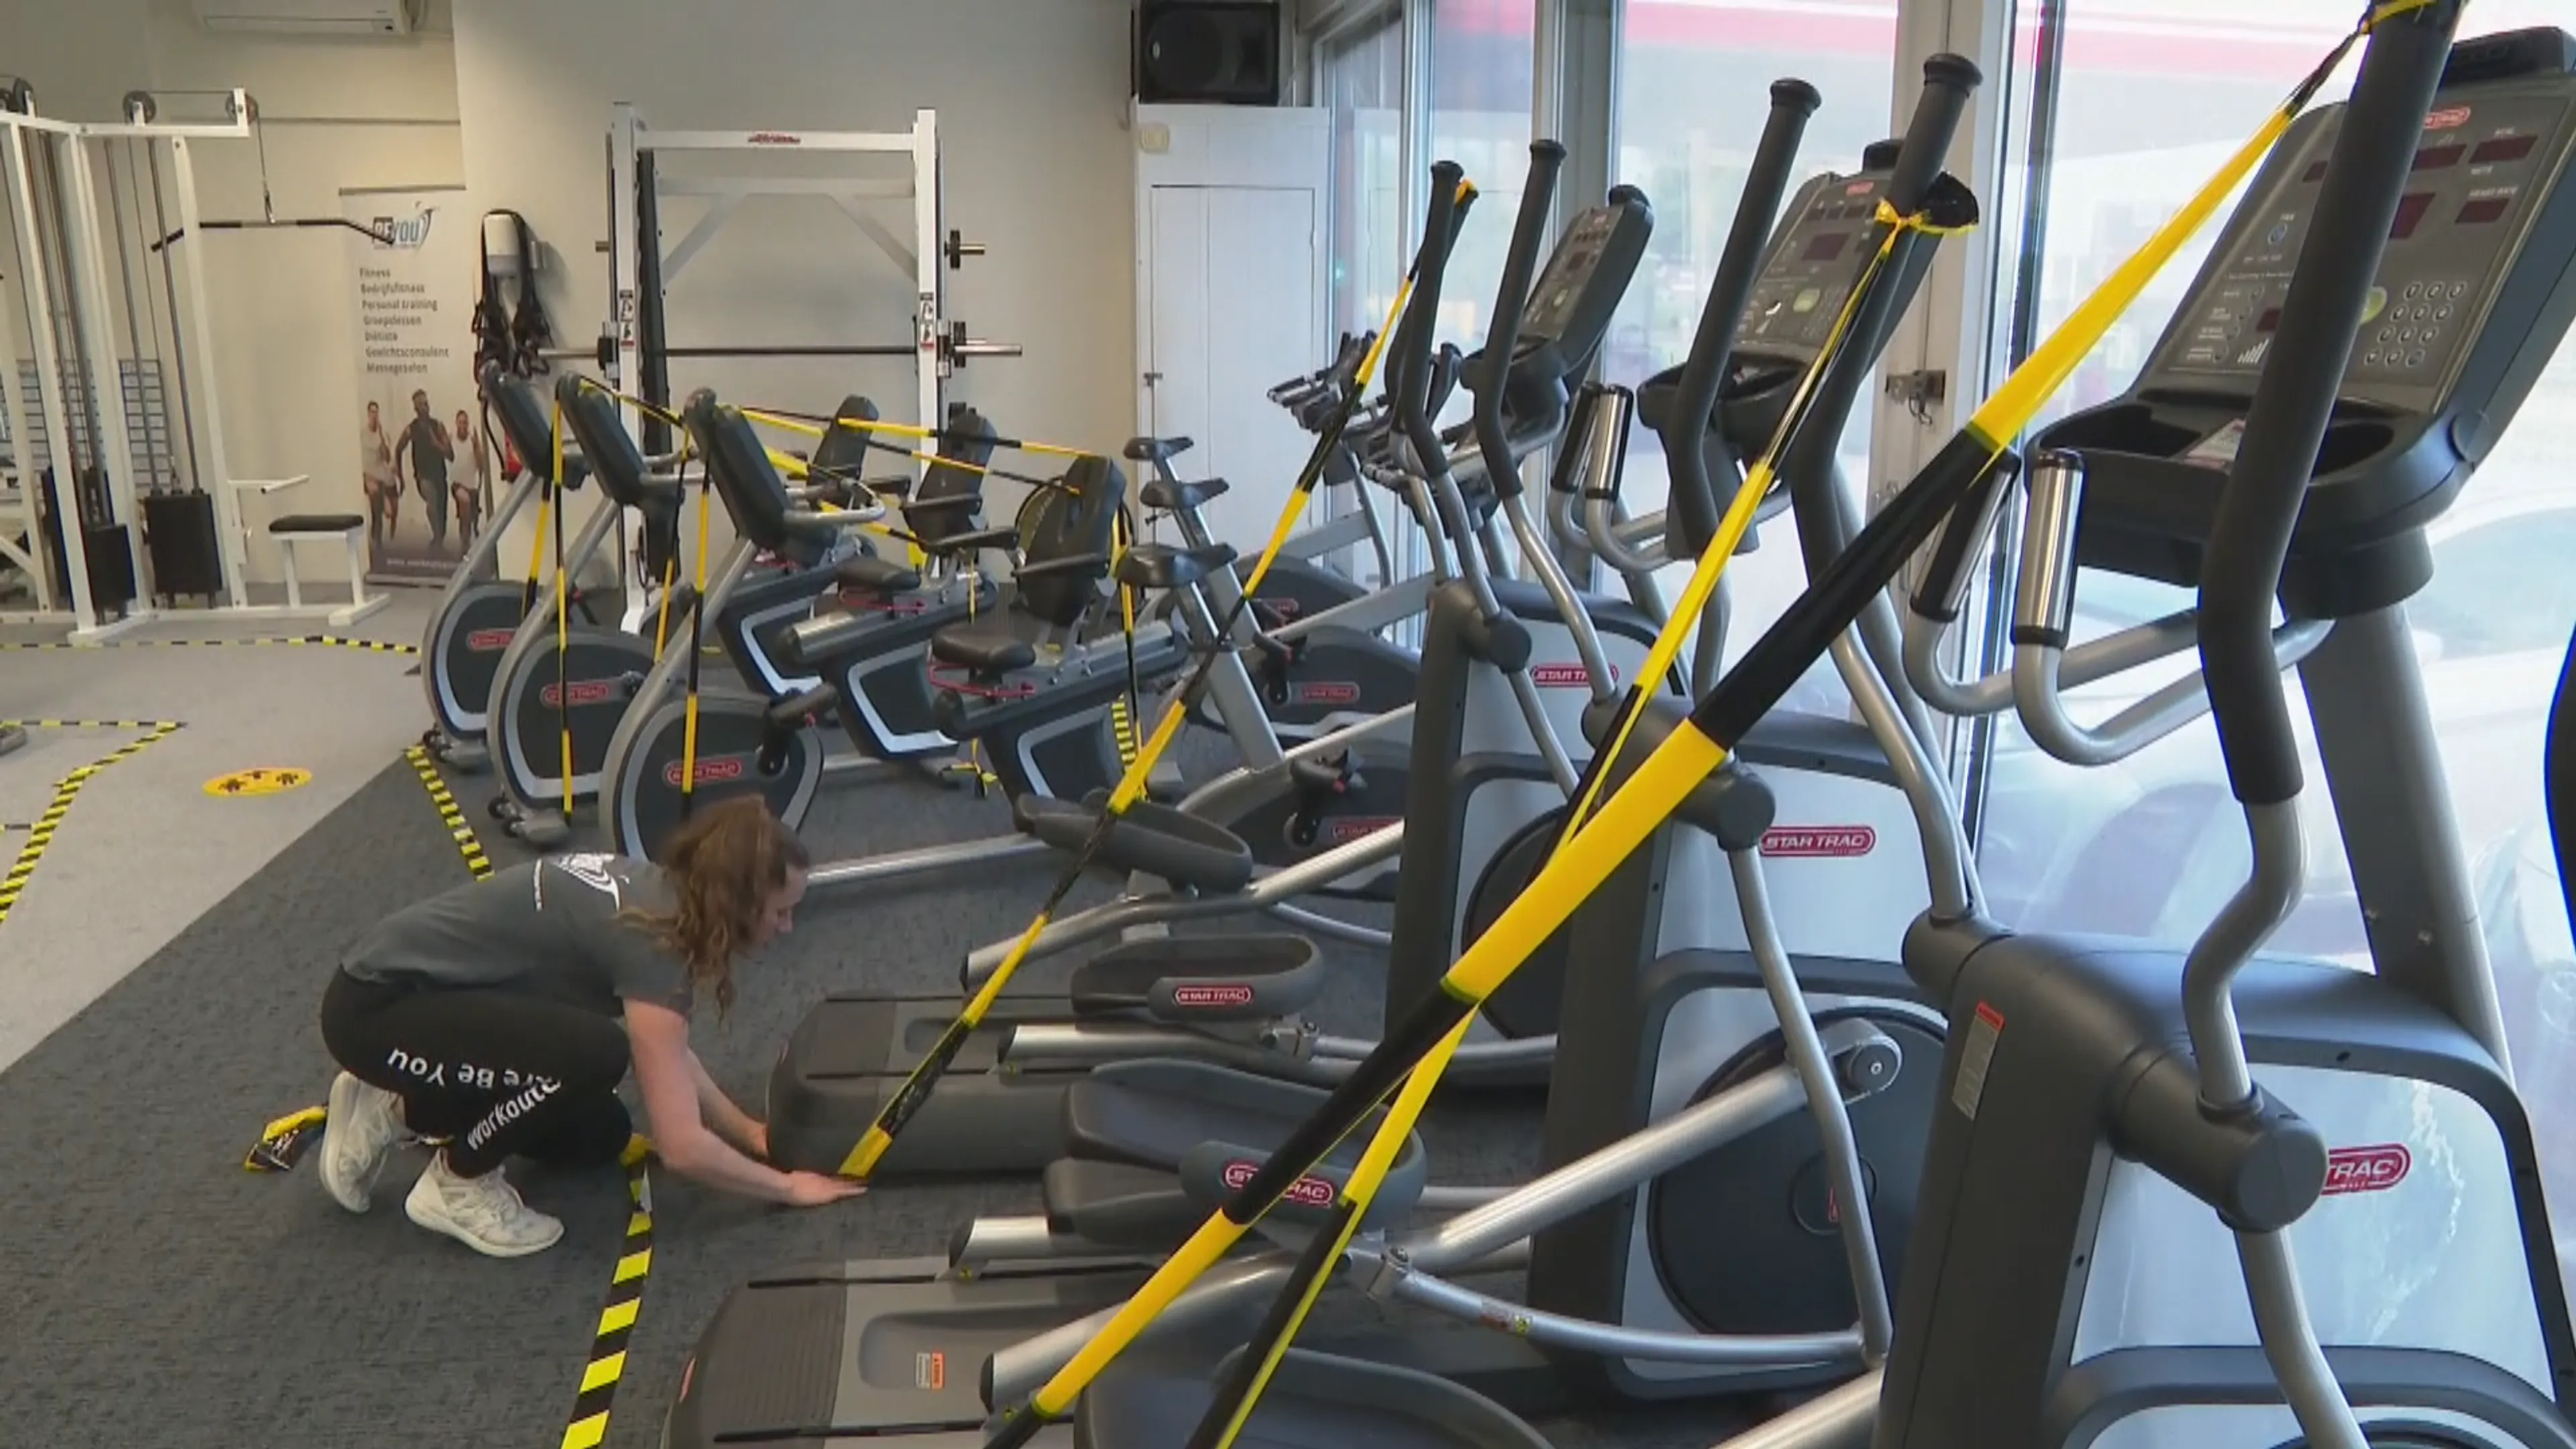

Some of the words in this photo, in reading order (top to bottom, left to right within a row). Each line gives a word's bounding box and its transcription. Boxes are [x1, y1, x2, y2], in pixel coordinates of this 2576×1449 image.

[360, 268, 390, 278] Fitness
[361, 282, 425, 296] Bedrijfsfitness
[362, 299, 400, 310] Personal
[402, 299, 437, 312] training
[1536, 670, 1572, 680] STAR
[1766, 836, 1813, 848] STAR
[1816, 835, 1865, 847] TRAC
[1181, 992, 1211, 1000] STAR
[1213, 992, 1246, 1000] TRAC
[387, 1047, 445, 1087] You
[458, 1063, 495, 1089] Be
